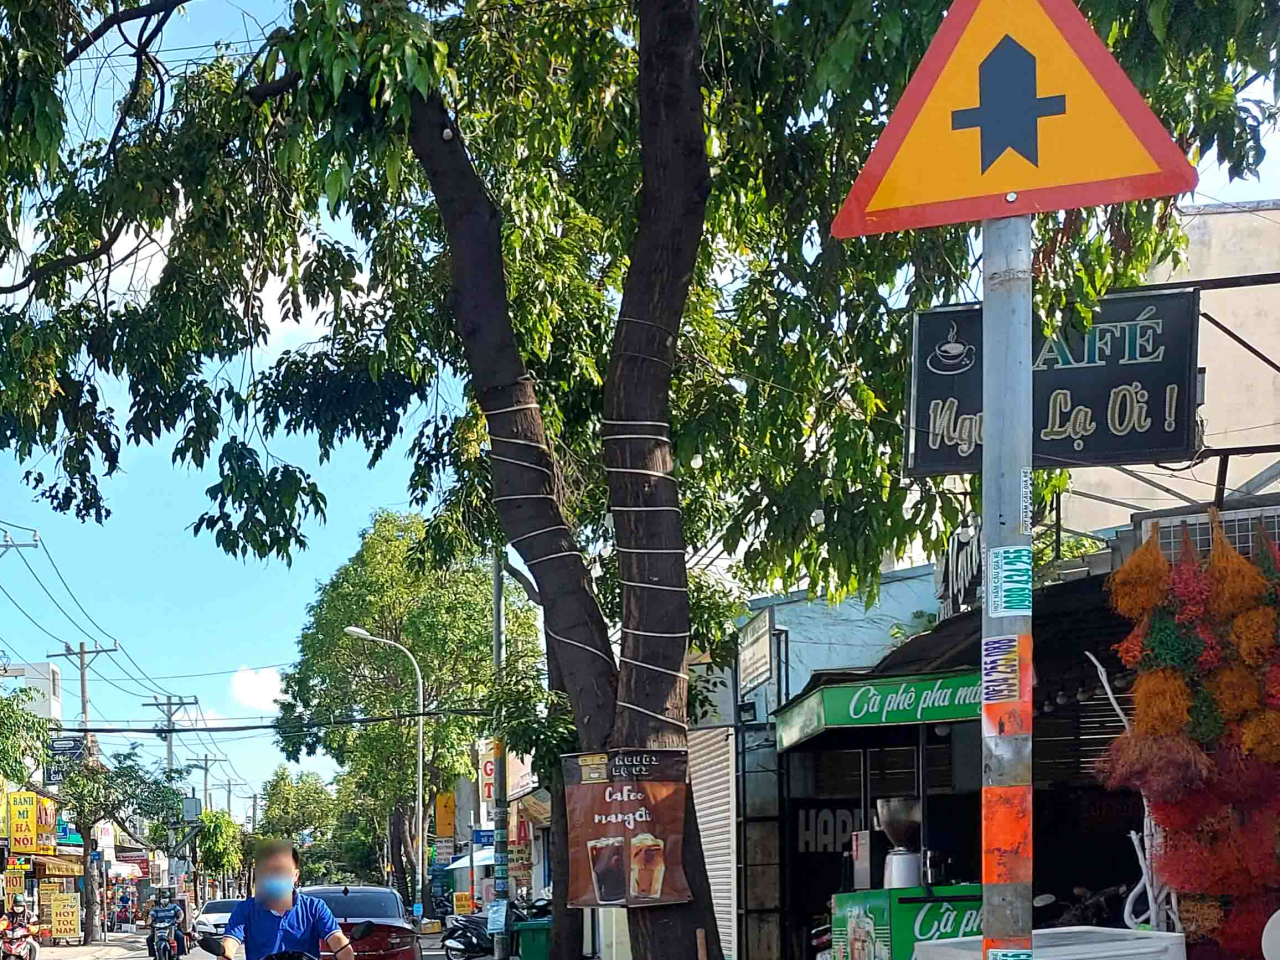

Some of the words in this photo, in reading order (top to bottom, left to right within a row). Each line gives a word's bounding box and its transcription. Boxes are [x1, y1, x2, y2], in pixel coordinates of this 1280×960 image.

[1040, 388, 1096, 451] Lạ
[1107, 381, 1152, 436] Ơi
[849, 685, 880, 719] Cà
[882, 683, 915, 722] phê
[917, 680, 949, 719] pha
